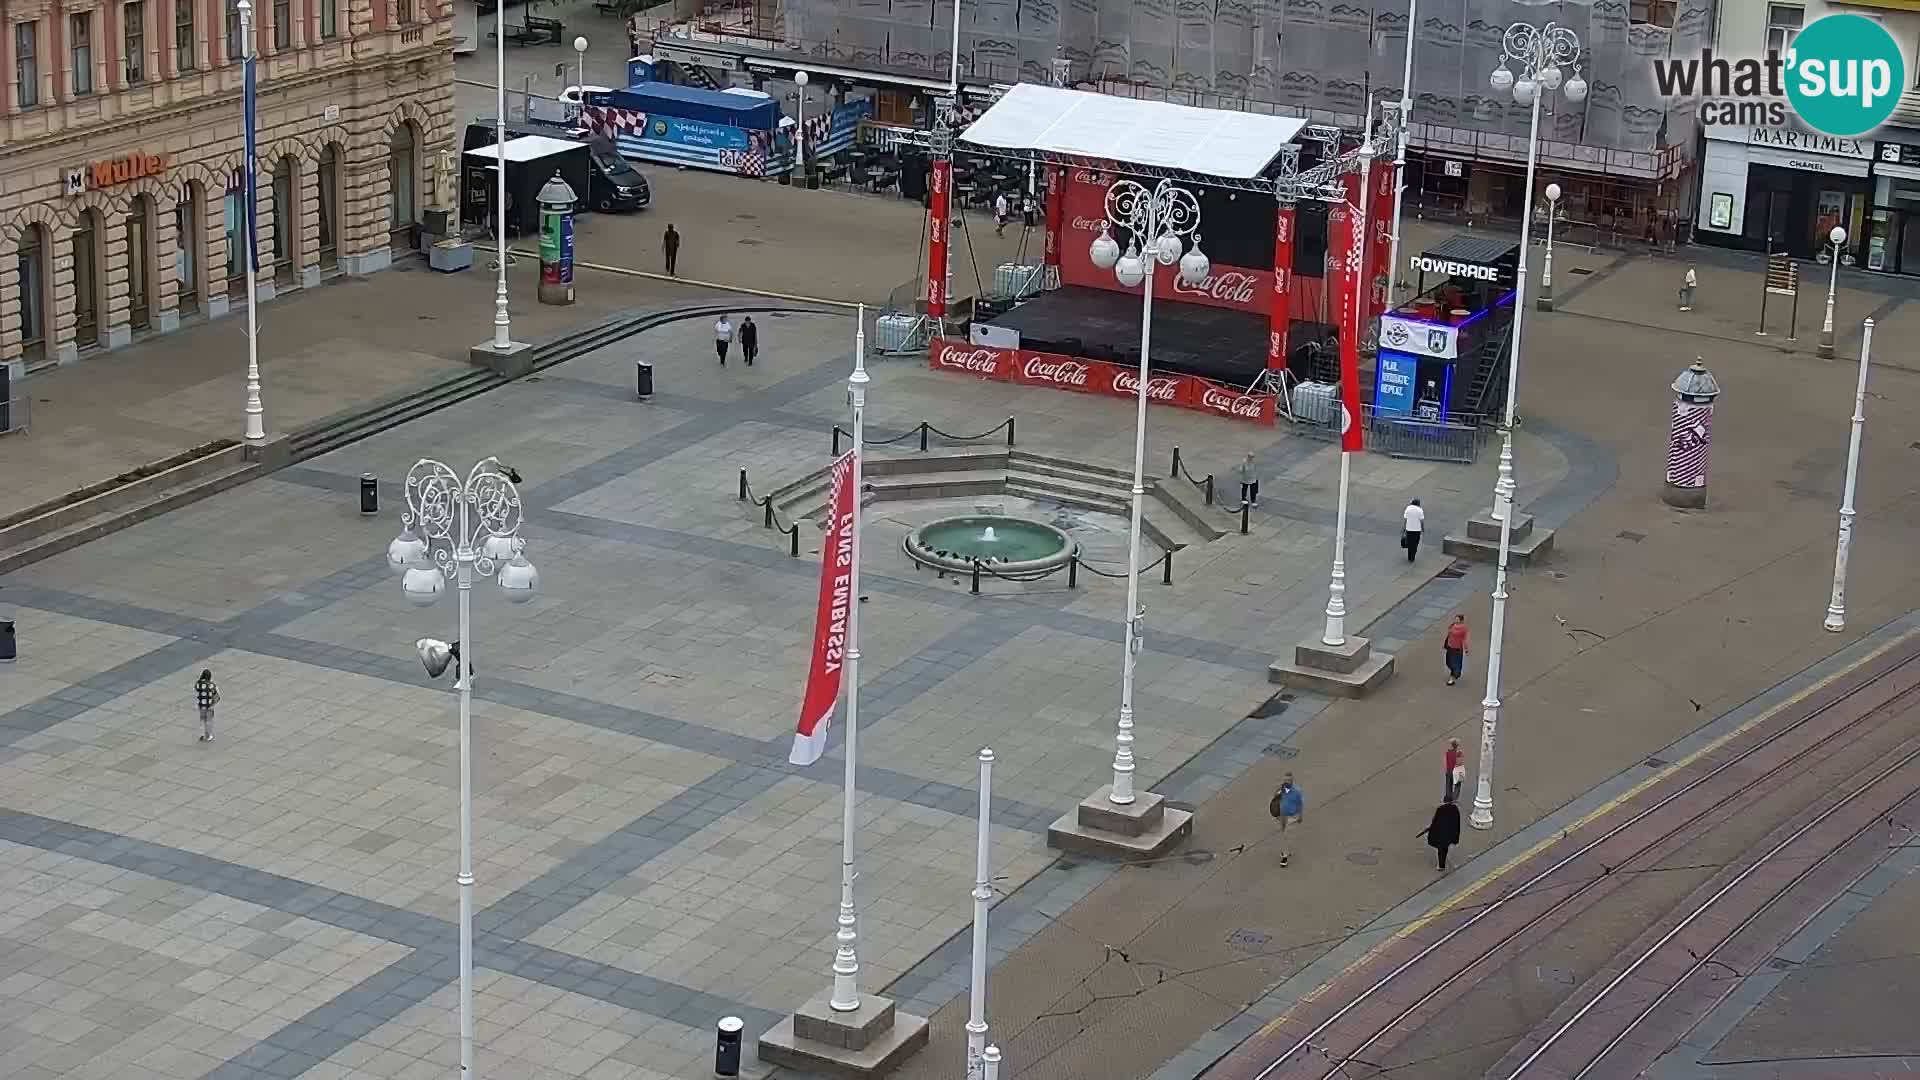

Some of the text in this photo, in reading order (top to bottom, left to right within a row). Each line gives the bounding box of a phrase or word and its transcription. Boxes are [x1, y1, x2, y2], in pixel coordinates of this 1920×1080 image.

[1753, 128, 1864, 155] MARTIMEX
[1410, 256, 1499, 282] POWERADE
[940, 345, 1000, 373] Coca-Cola
[1023, 356, 1090, 385] Coca-Cola
[1202, 388, 1265, 417] Coca-Cola
